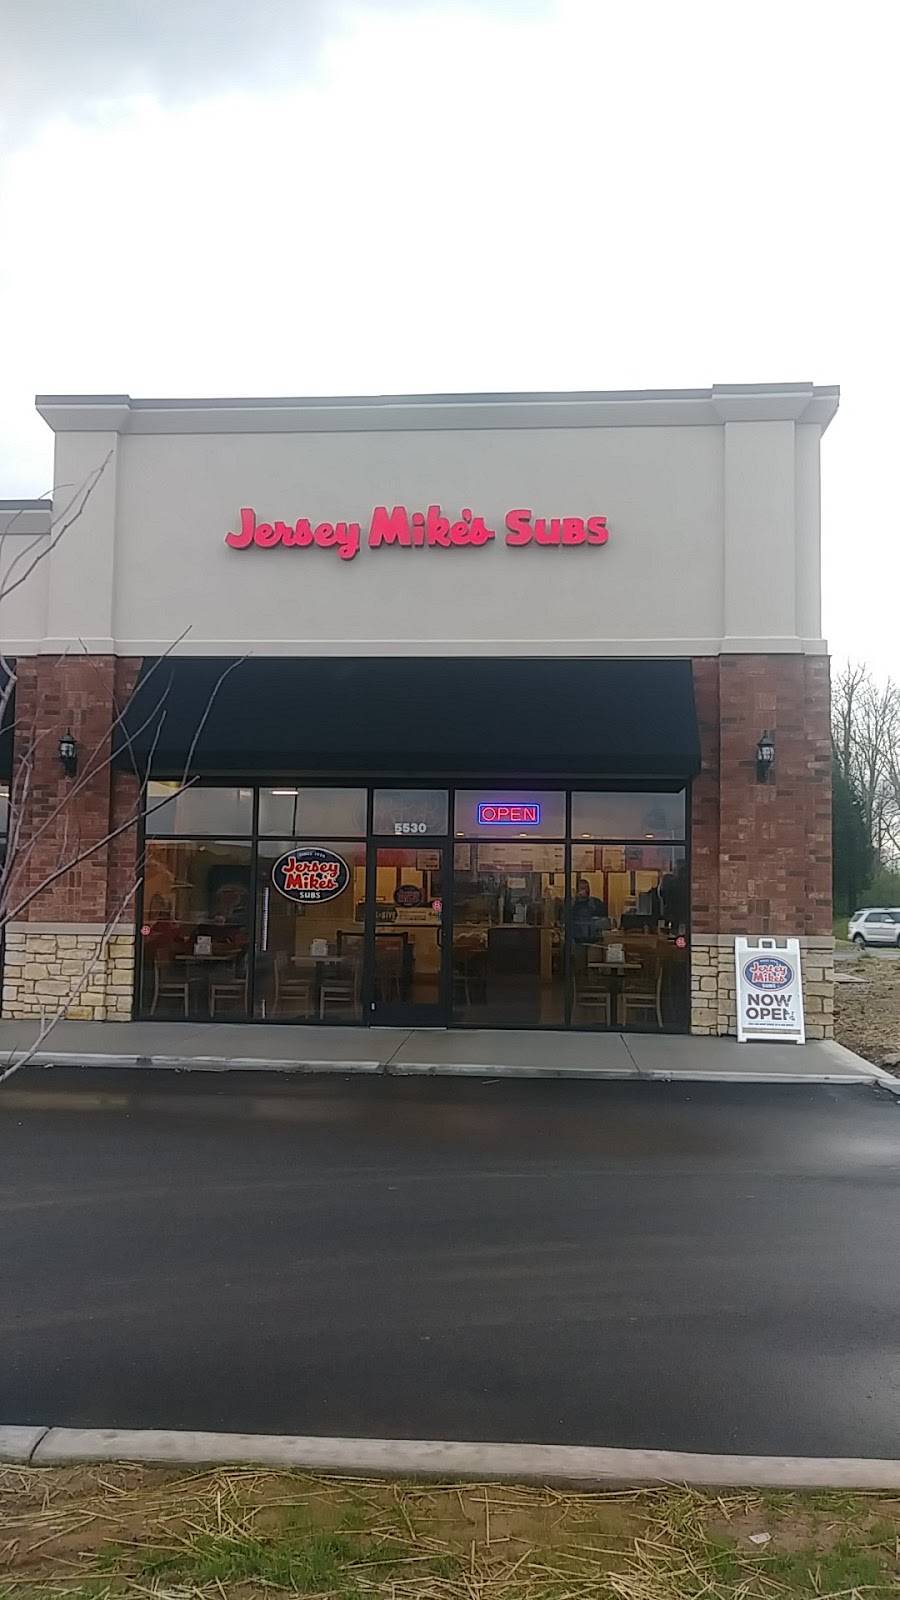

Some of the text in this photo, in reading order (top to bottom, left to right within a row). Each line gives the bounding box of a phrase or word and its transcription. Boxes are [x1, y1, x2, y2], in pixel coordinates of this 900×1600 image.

[225, 506, 360, 561] Jersey
[368, 504, 496, 549] Mike's
[481, 807, 537, 822] OPEN
[394, 823, 427, 834] 5530
[281, 856, 341, 878] Jersey
[747, 994, 793, 1007] NOW
